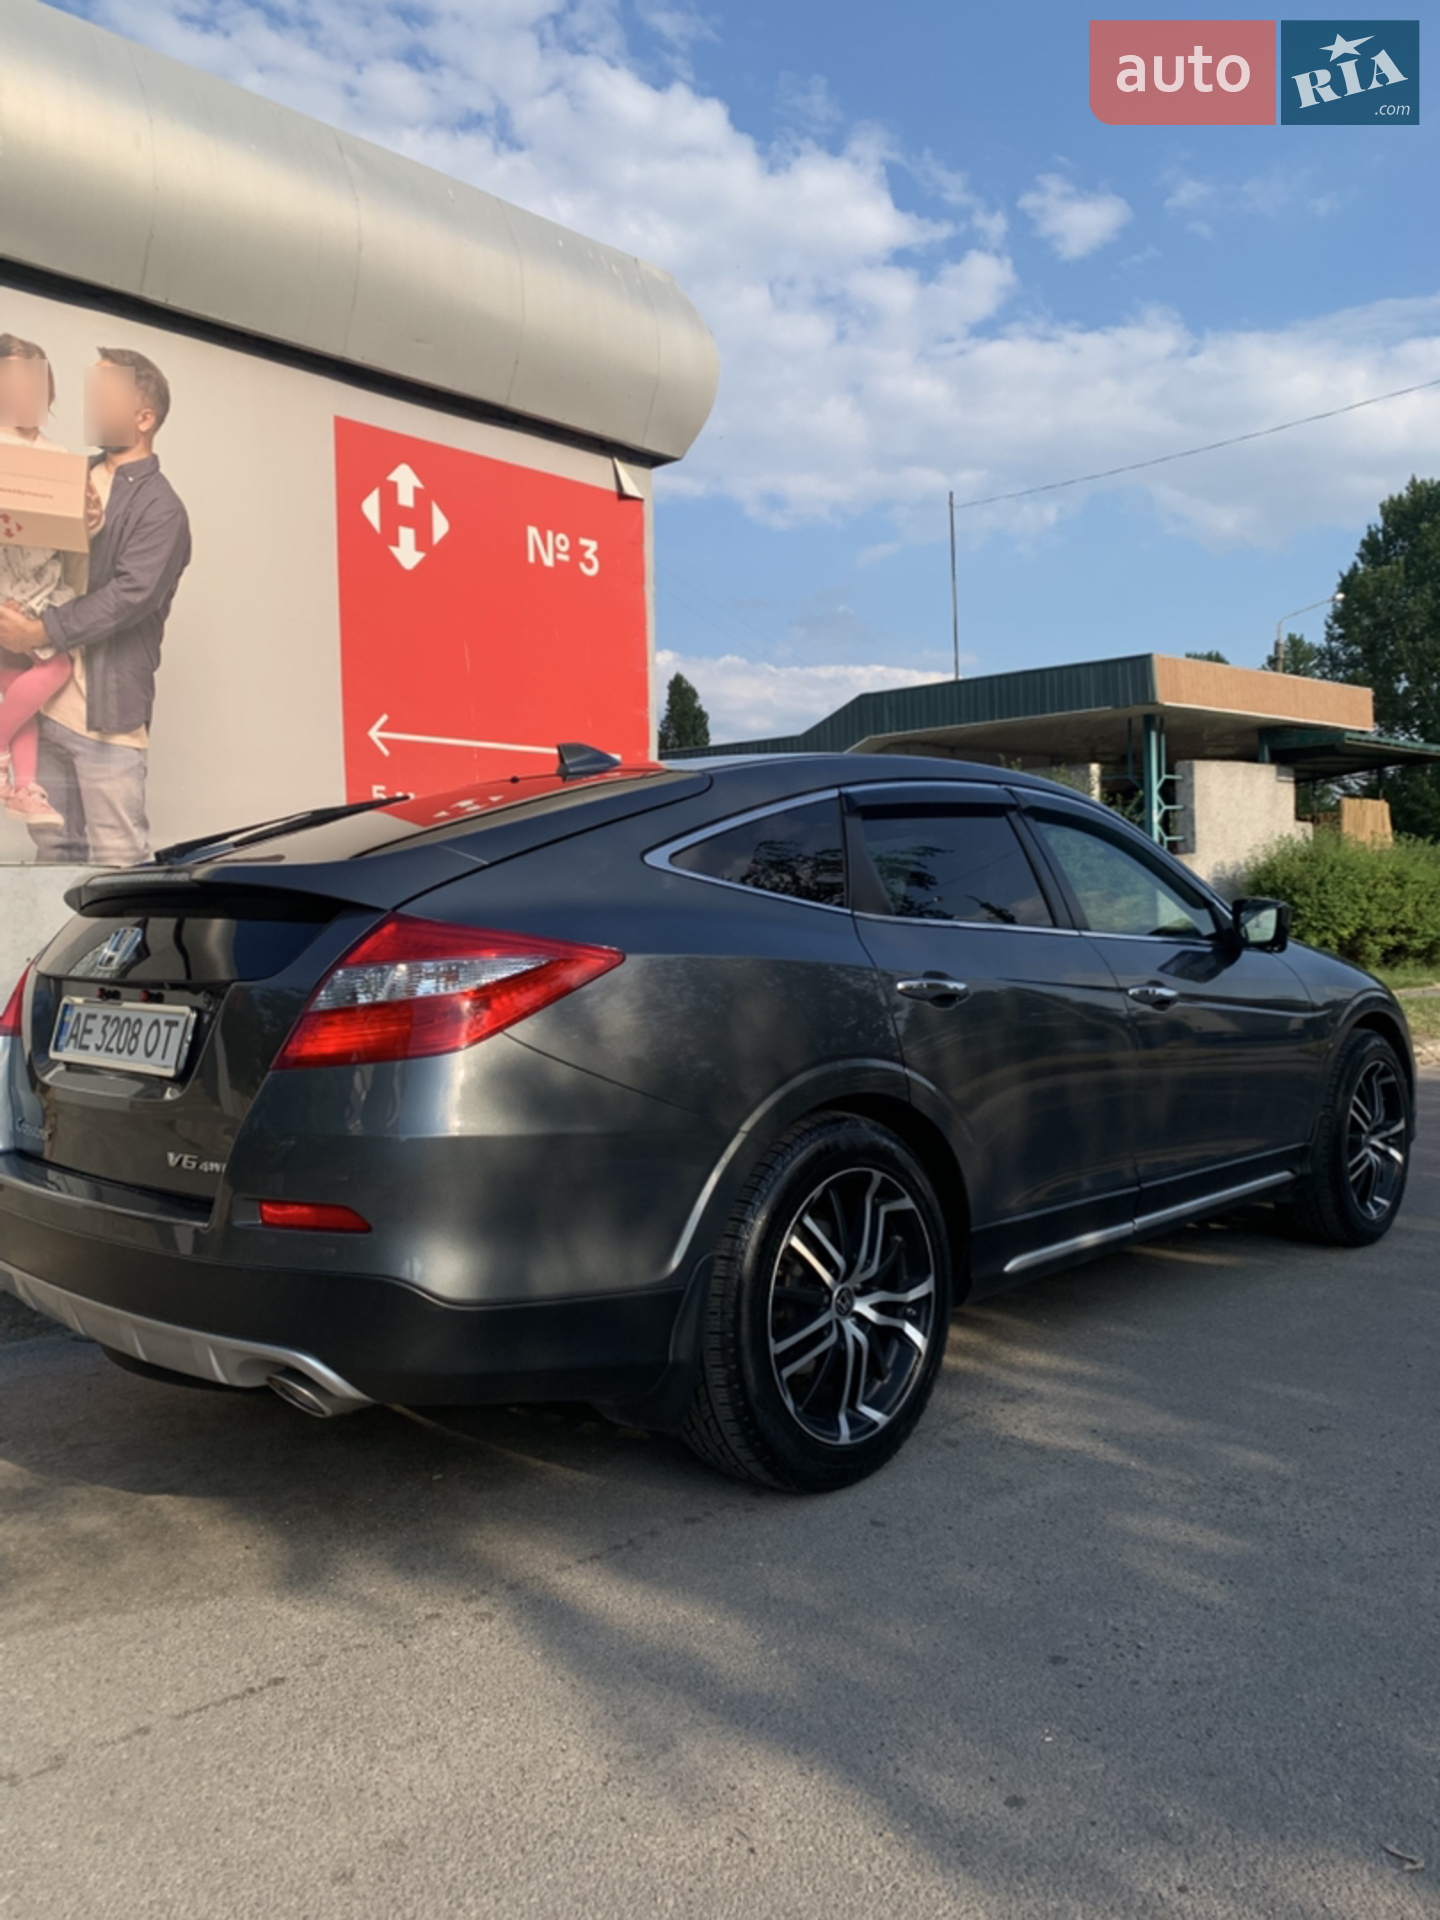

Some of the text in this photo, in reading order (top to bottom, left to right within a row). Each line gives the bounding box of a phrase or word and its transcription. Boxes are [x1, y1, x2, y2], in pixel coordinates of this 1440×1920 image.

[578, 537, 600, 577] 3
[65, 1012, 179, 1061] AE 3208 OT
[166, 1151, 199, 1170] V6
